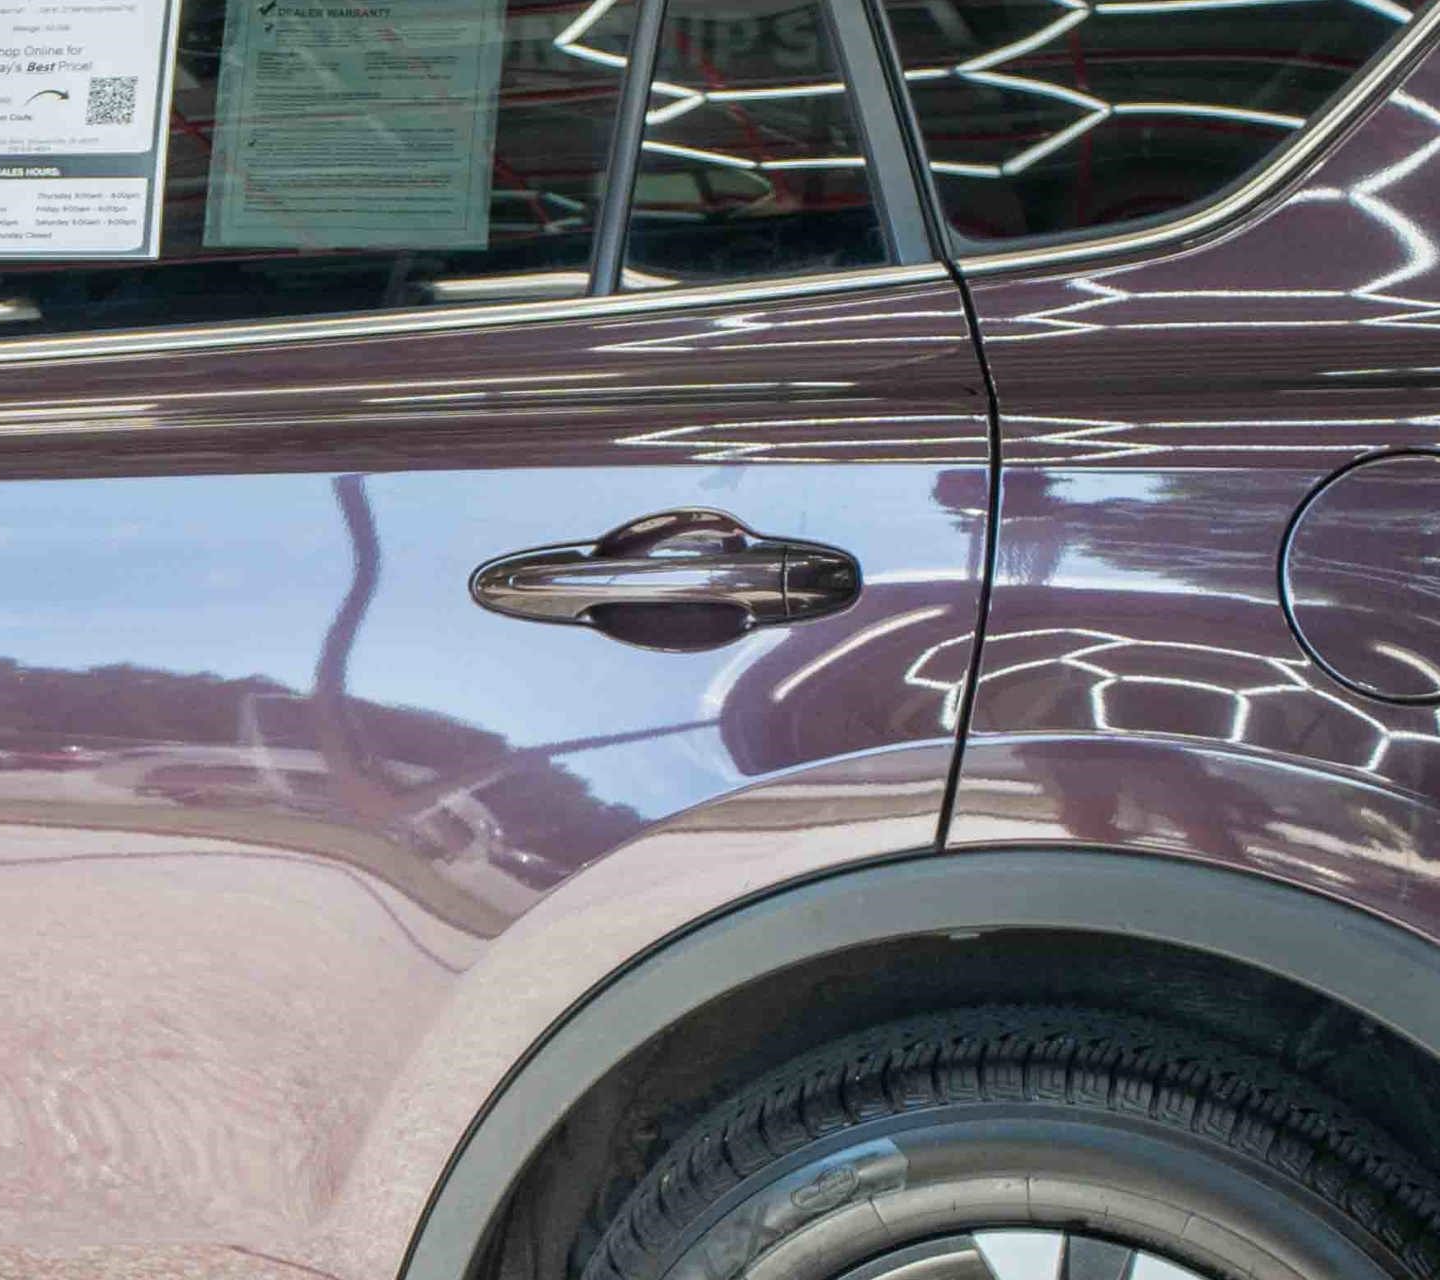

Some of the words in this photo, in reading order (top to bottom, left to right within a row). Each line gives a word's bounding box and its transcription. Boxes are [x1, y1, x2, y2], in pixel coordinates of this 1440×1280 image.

[23, 44, 64, 57] Online
[65, 44, 84, 57] for
[25, 61, 57, 74] Best
[57, 60, 93, 73] Price!
